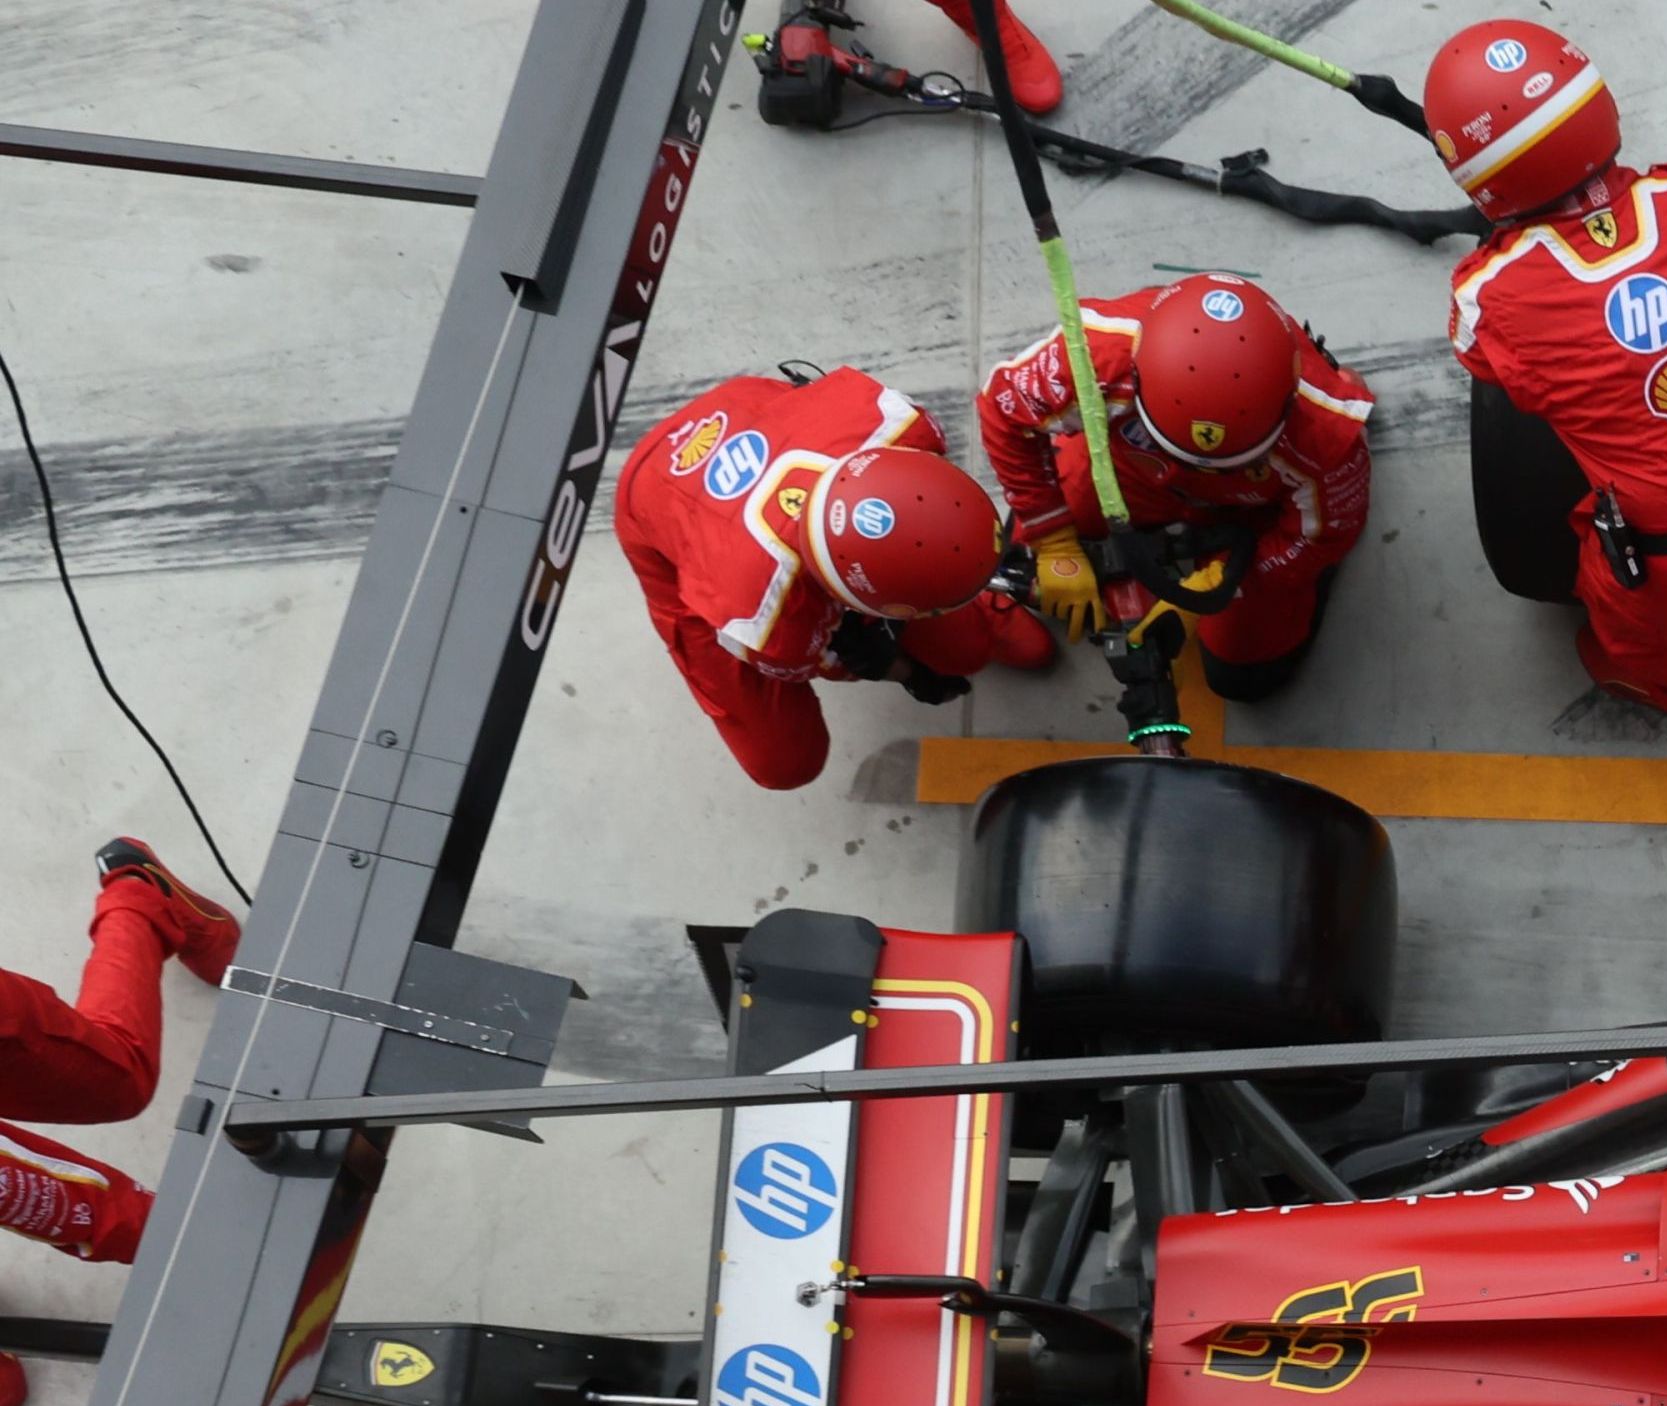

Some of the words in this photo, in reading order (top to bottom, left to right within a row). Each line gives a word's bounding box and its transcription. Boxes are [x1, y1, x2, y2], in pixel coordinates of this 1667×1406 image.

[1490, 42, 1522, 70] hp
[1208, 291, 1239, 320] hp
[714, 435, 764, 494] hp
[857, 500, 893, 538] hp
[735, 1145, 838, 1233] hp
[1203, 1322, 1383, 1394] 55
